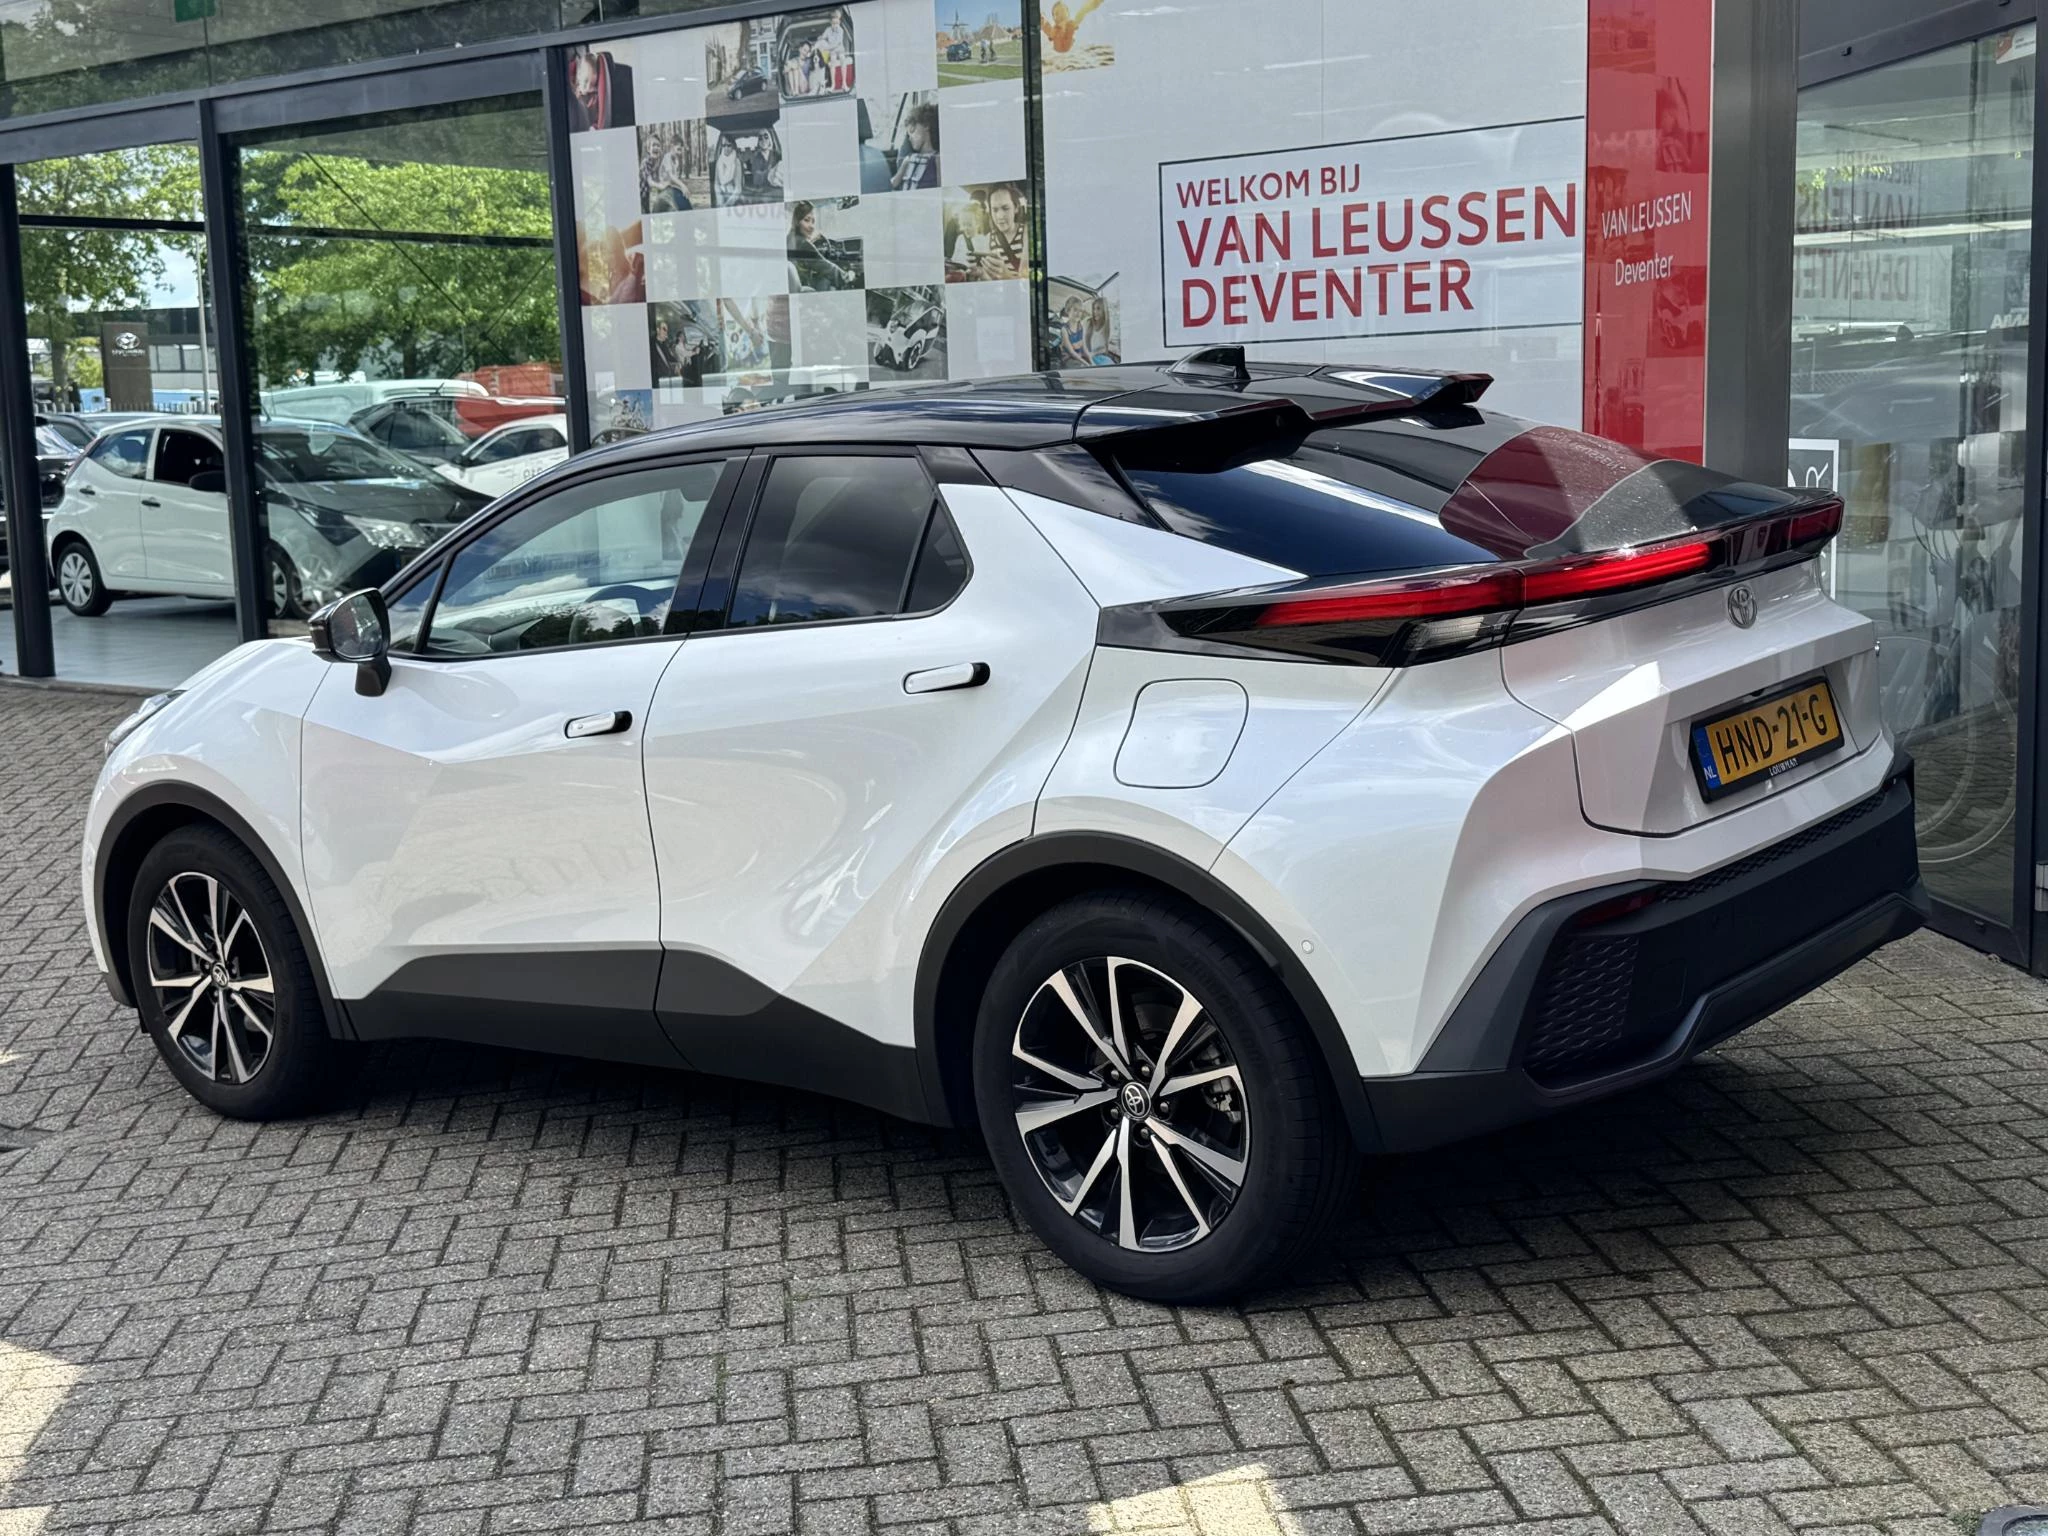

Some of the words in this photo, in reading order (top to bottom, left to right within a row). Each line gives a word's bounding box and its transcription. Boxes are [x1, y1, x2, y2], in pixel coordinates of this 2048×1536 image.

[1176, 169, 1310, 209] WELKOM
[1320, 163, 1361, 196] BIJ
[1177, 210, 1291, 269] VAN
[1312, 182, 1577, 259] LEUSSEN
[1601, 206, 1629, 240] VAN
[1631, 190, 1692, 233] LEUSSEN
[1181, 258, 1475, 329] DEVENTER
[1615, 253, 1674, 287] Deventer
[1715, 693, 1828, 775] HND-21-G
[1703, 767, 1718, 781] NL
